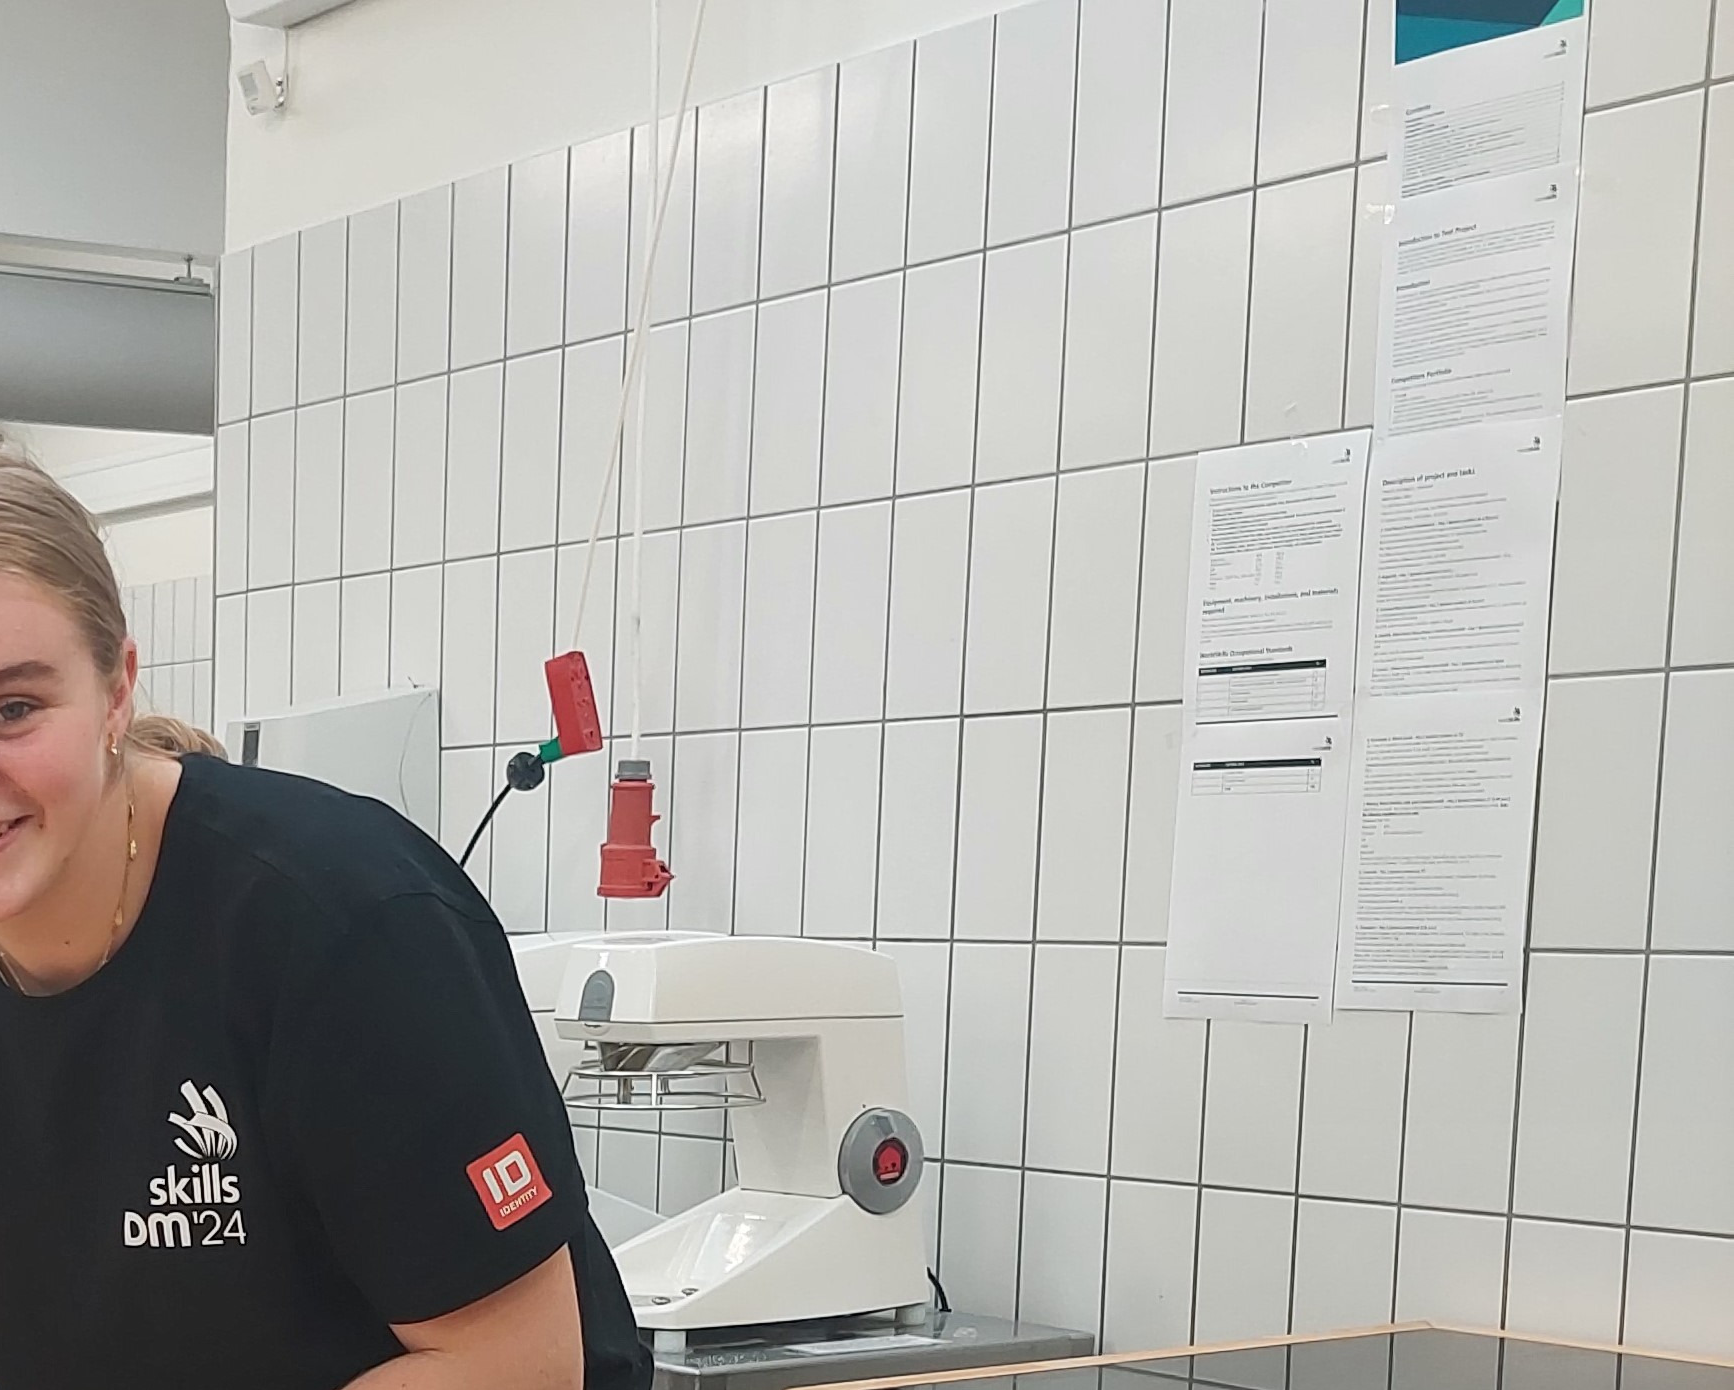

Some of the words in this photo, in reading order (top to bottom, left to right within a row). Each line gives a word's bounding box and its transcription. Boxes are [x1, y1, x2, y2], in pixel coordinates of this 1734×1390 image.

[149, 1162, 241, 1206] skills
[482, 1150, 532, 1204] ID
[499, 1185, 538, 1218] IDENTITY
